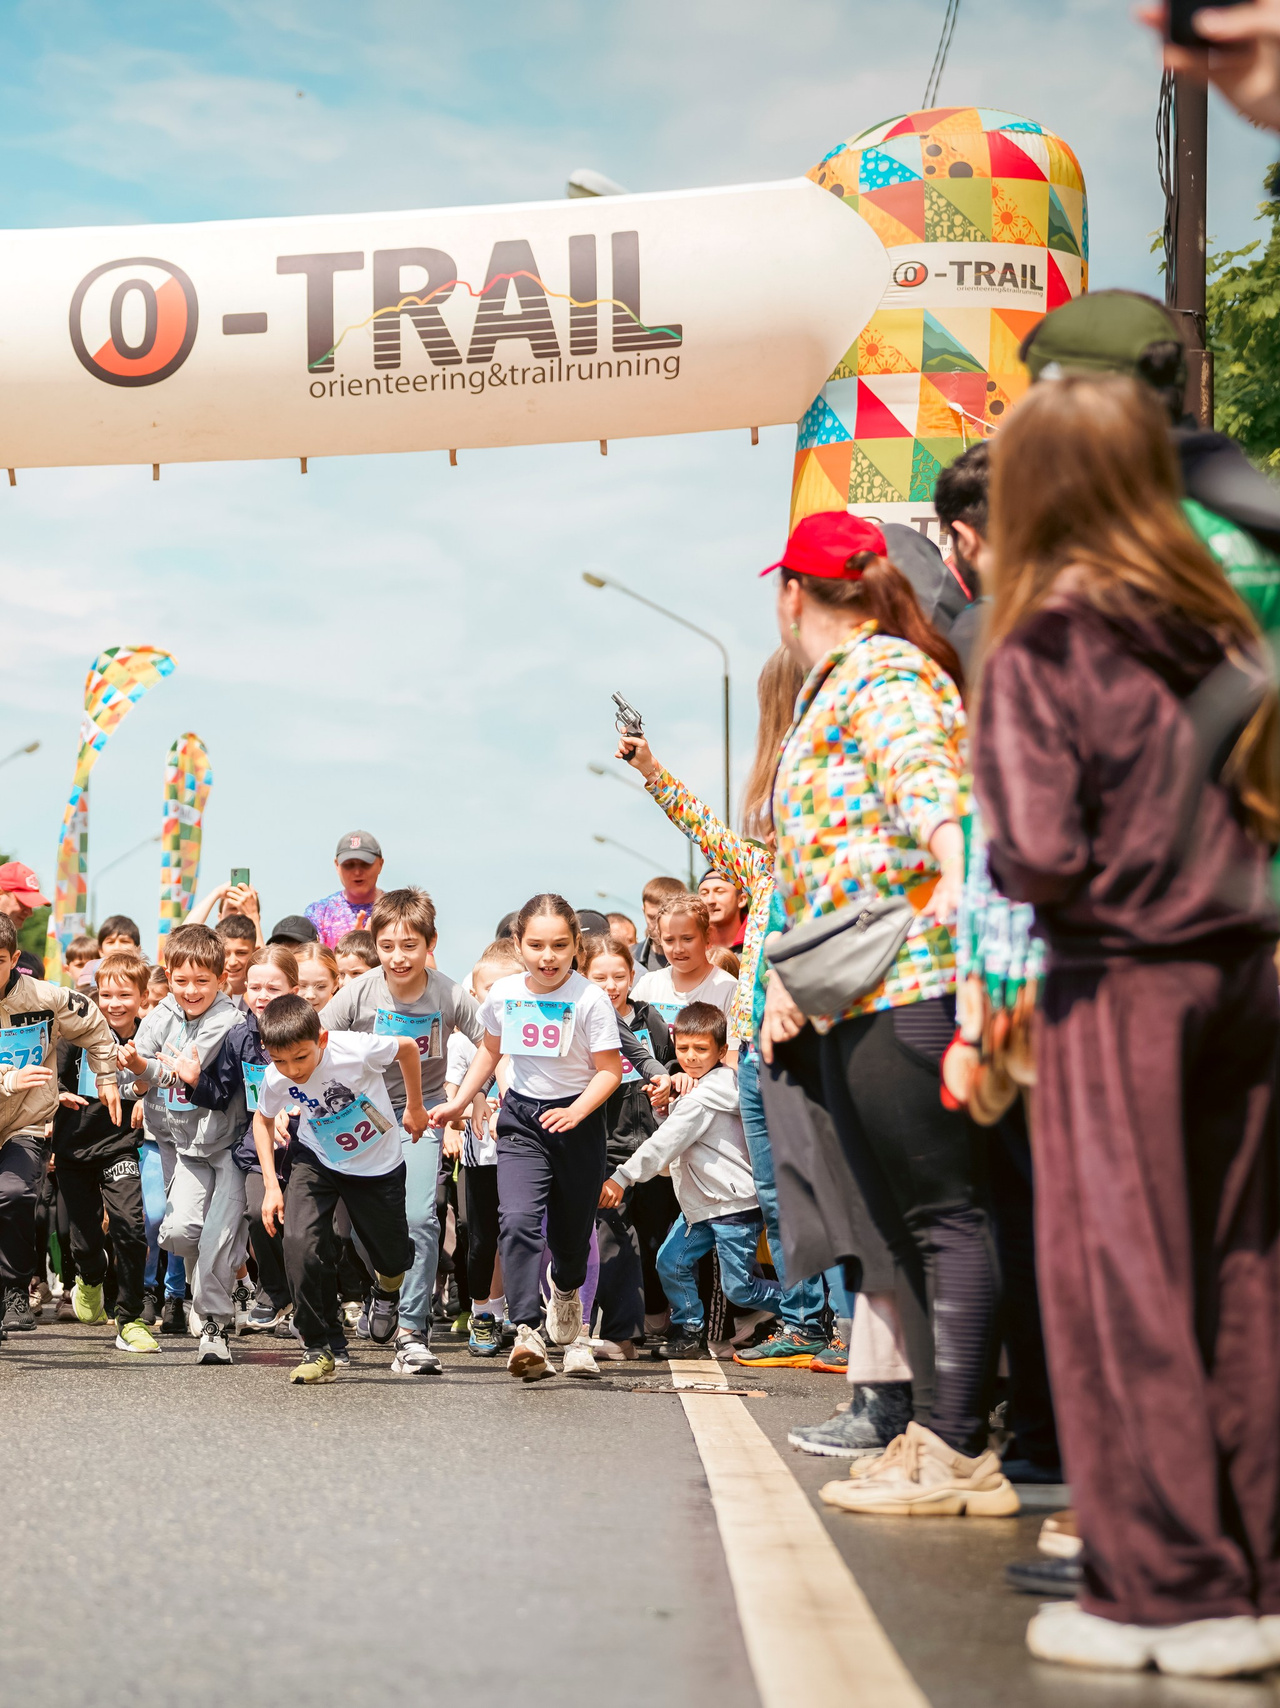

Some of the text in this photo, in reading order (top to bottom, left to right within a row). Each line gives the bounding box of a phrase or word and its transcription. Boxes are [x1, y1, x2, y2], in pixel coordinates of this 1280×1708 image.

[309, 352, 680, 398] orienteering&trailrunning
[415, 1035, 429, 1056] 8
[522, 1023, 560, 1049] 99
[335, 1120, 378, 1152] 92
